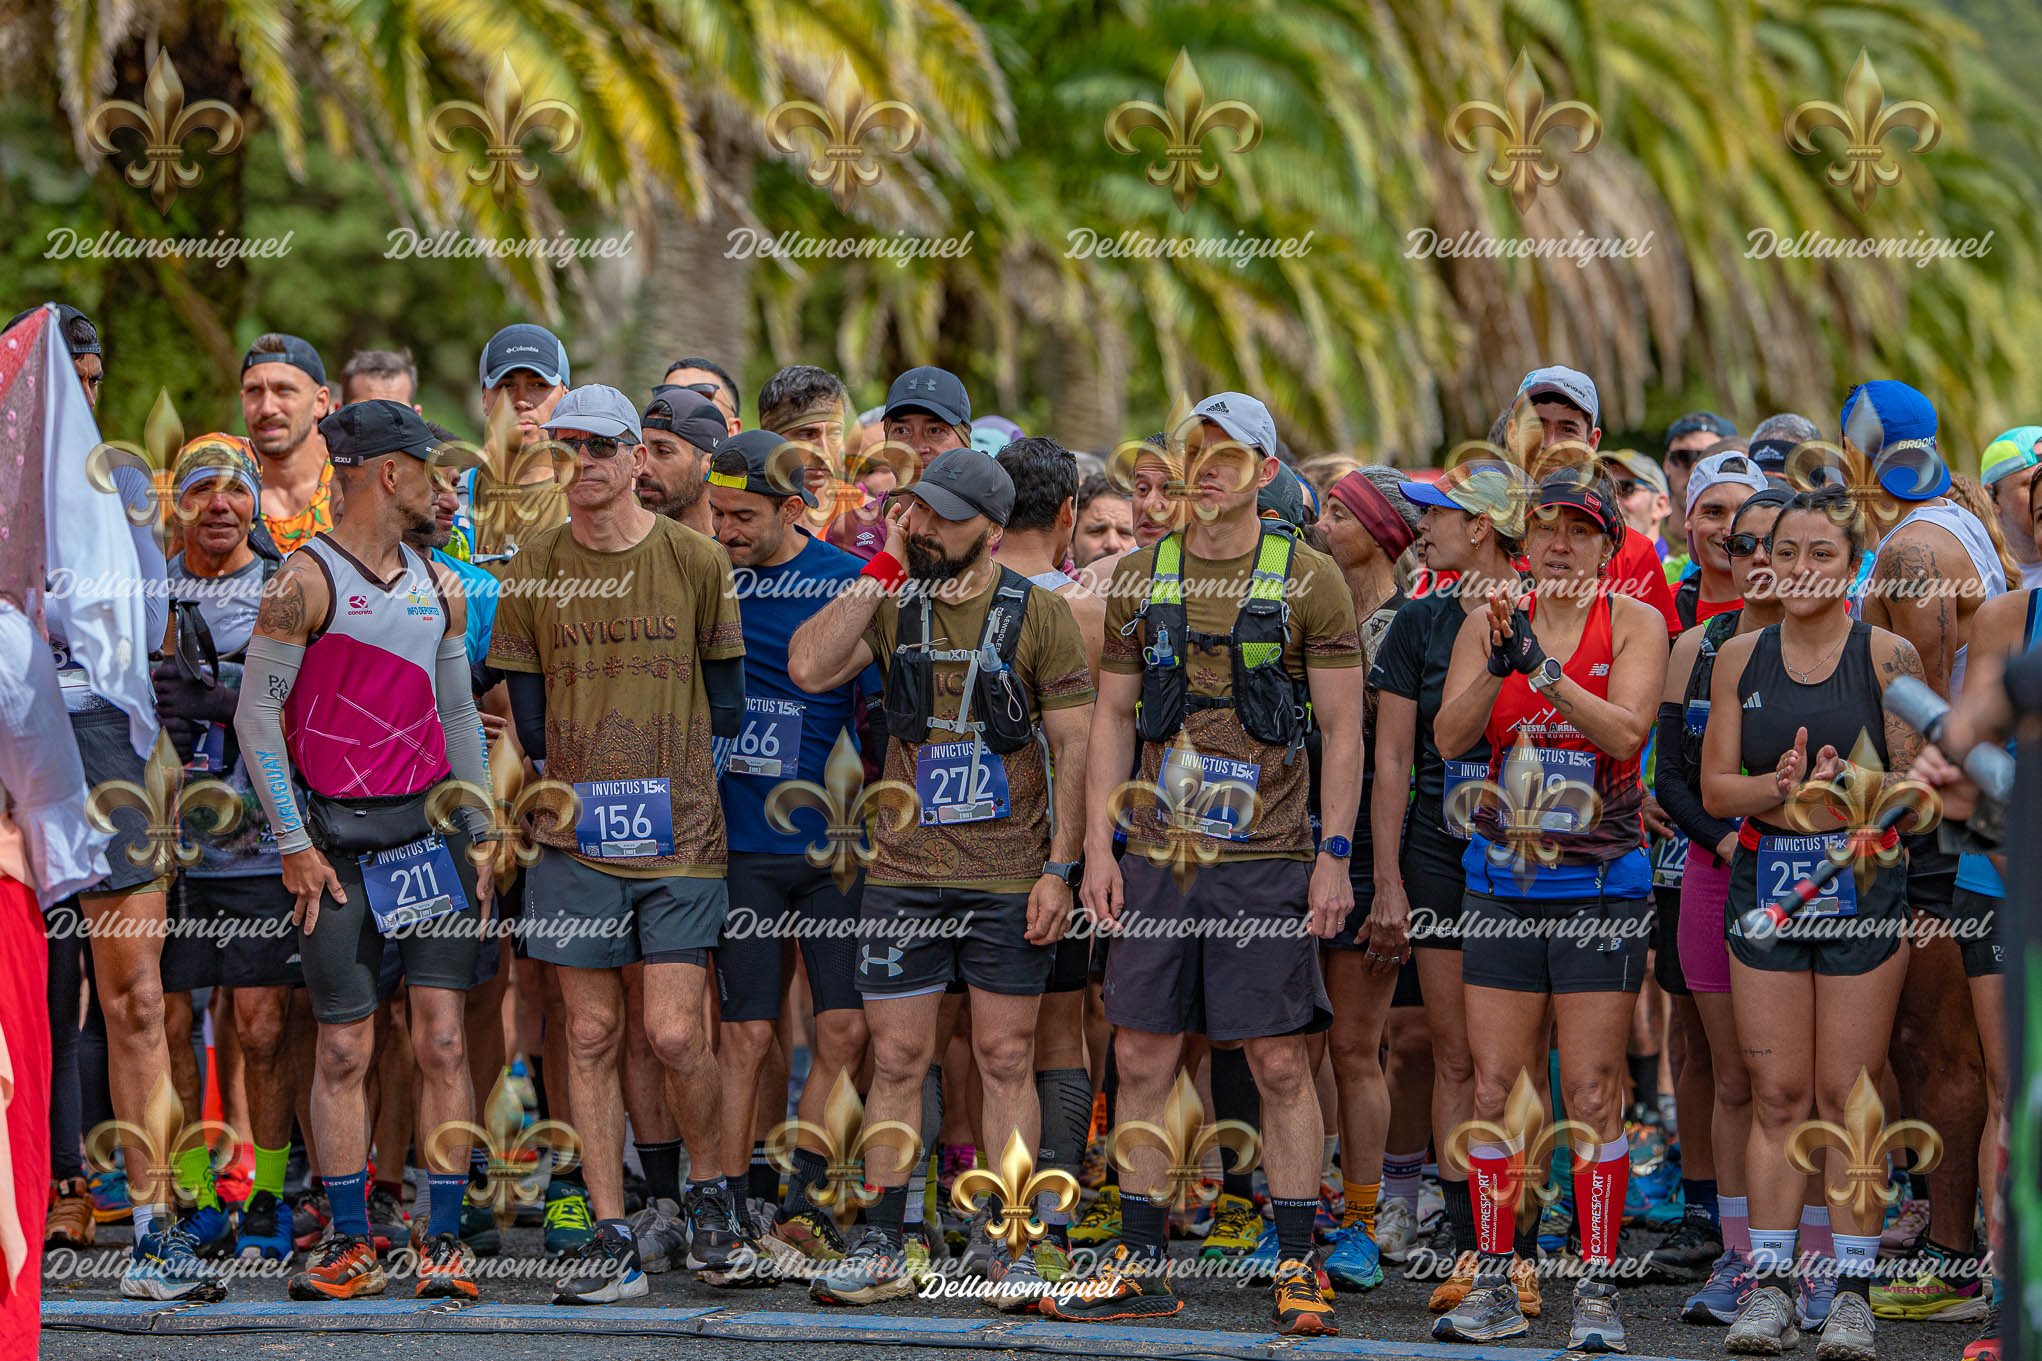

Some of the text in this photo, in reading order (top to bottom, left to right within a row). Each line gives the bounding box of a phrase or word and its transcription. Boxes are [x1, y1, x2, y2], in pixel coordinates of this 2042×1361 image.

[334, 456, 352, 464] 2XU
[553, 615, 678, 649] INVICTUS
[745, 697, 776, 713] ICTUS
[1549, 722, 1578, 732] ARRI
[931, 742, 975, 759] INVICTUS
[1518, 748, 1593, 768] INVICTUS 15K
[1181, 752, 1254, 780] INVICTUS 15K
[1461, 763, 1490, 778] INVICT
[256, 750, 301, 832] URUGUAY
[592, 780, 667, 796] INVICTUS 15K
[930, 763, 994, 804] 272
[1521, 771, 1567, 809] 119
[1176, 777, 1233, 820] 271
[594, 803, 652, 840] 156
[1308, 815, 1322, 828] 5K
[377, 842, 424, 865] INVICTUS
[1774, 837, 1821, 851] INVICTUS
[390, 862, 440, 906] 211
[1478, 1172, 1491, 1251] COMPRESSPORT
[1591, 1174, 1604, 1254] COMPRESSPORT
